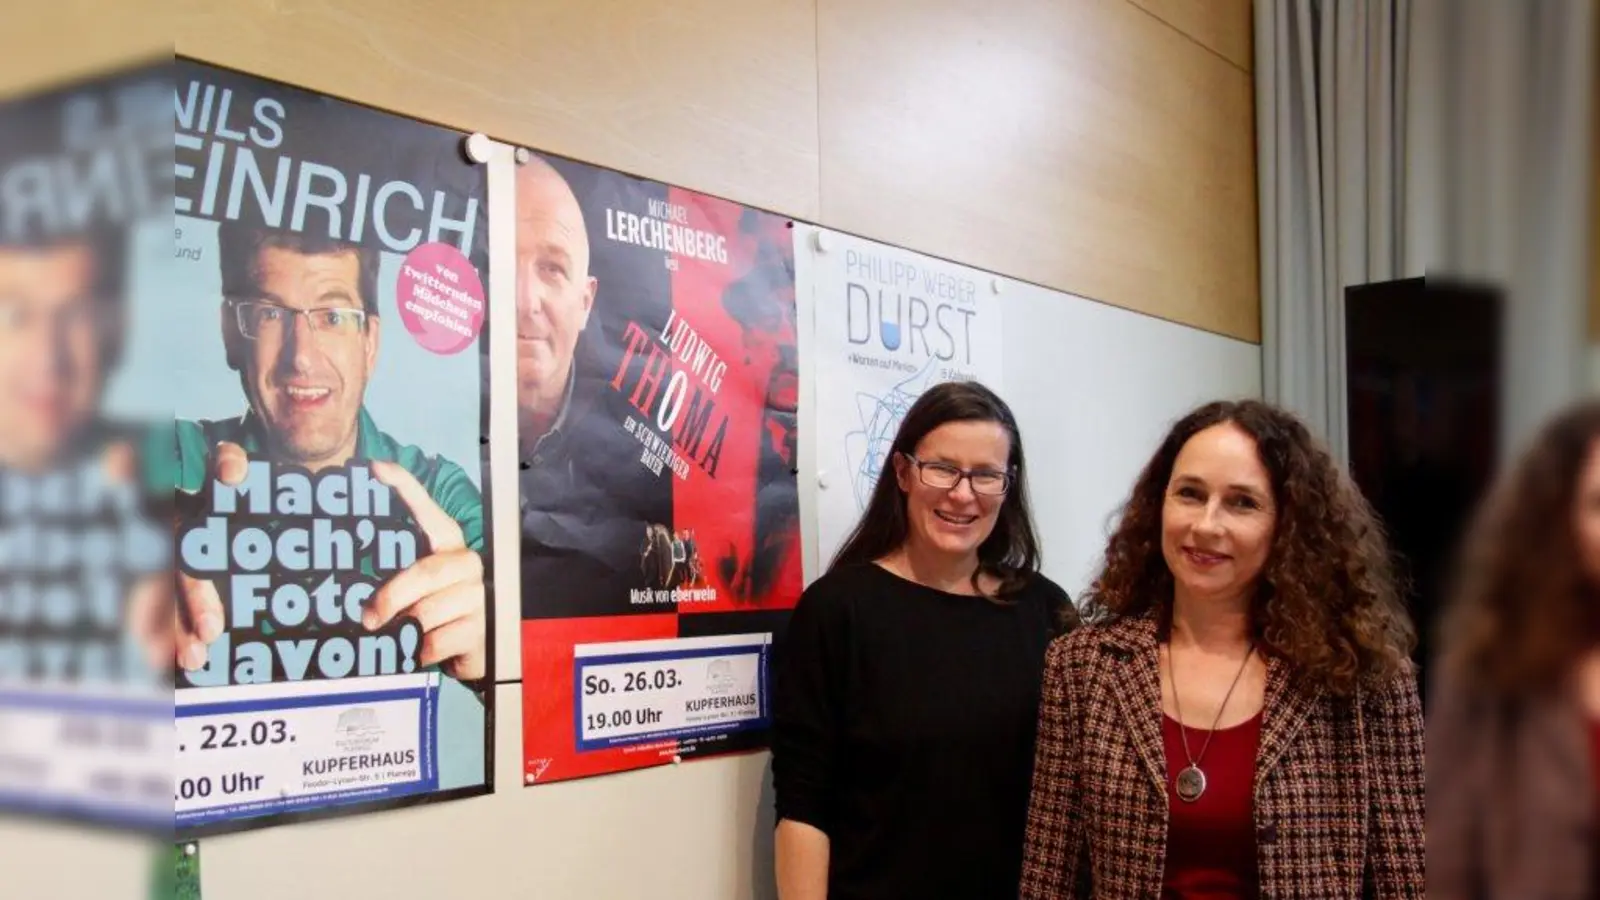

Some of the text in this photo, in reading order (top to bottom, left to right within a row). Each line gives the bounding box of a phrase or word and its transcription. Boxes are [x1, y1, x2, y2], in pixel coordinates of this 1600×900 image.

[175, 80, 285, 148] NILS
[648, 197, 688, 224] MICHAEL
[606, 208, 728, 264] LERCHENBERG
[404, 265, 482, 311] twitternden
[436, 263, 459, 283] von
[846, 250, 976, 305] PHILIPP WEBER
[405, 300, 472, 337] empfohlen
[413, 284, 468, 320] Mädchen
[847, 282, 976, 365] DURST
[659, 309, 728, 395] LUDWIG
[610, 320, 729, 479] THOMA
[213, 461, 390, 516] Mach
[630, 585, 716, 604] Musik von eberwein
[183, 622, 417, 687] davon!
[585, 669, 682, 695] So. 26.03.
[587, 709, 632, 731] 19.00
[637, 708, 663, 725] Uhr
[685, 694, 756, 712] KUPFERHAUS
[200, 720, 296, 750] 22.03.
[302, 749, 415, 776] KUPFERHAUS
[221, 771, 264, 793] Uhr
